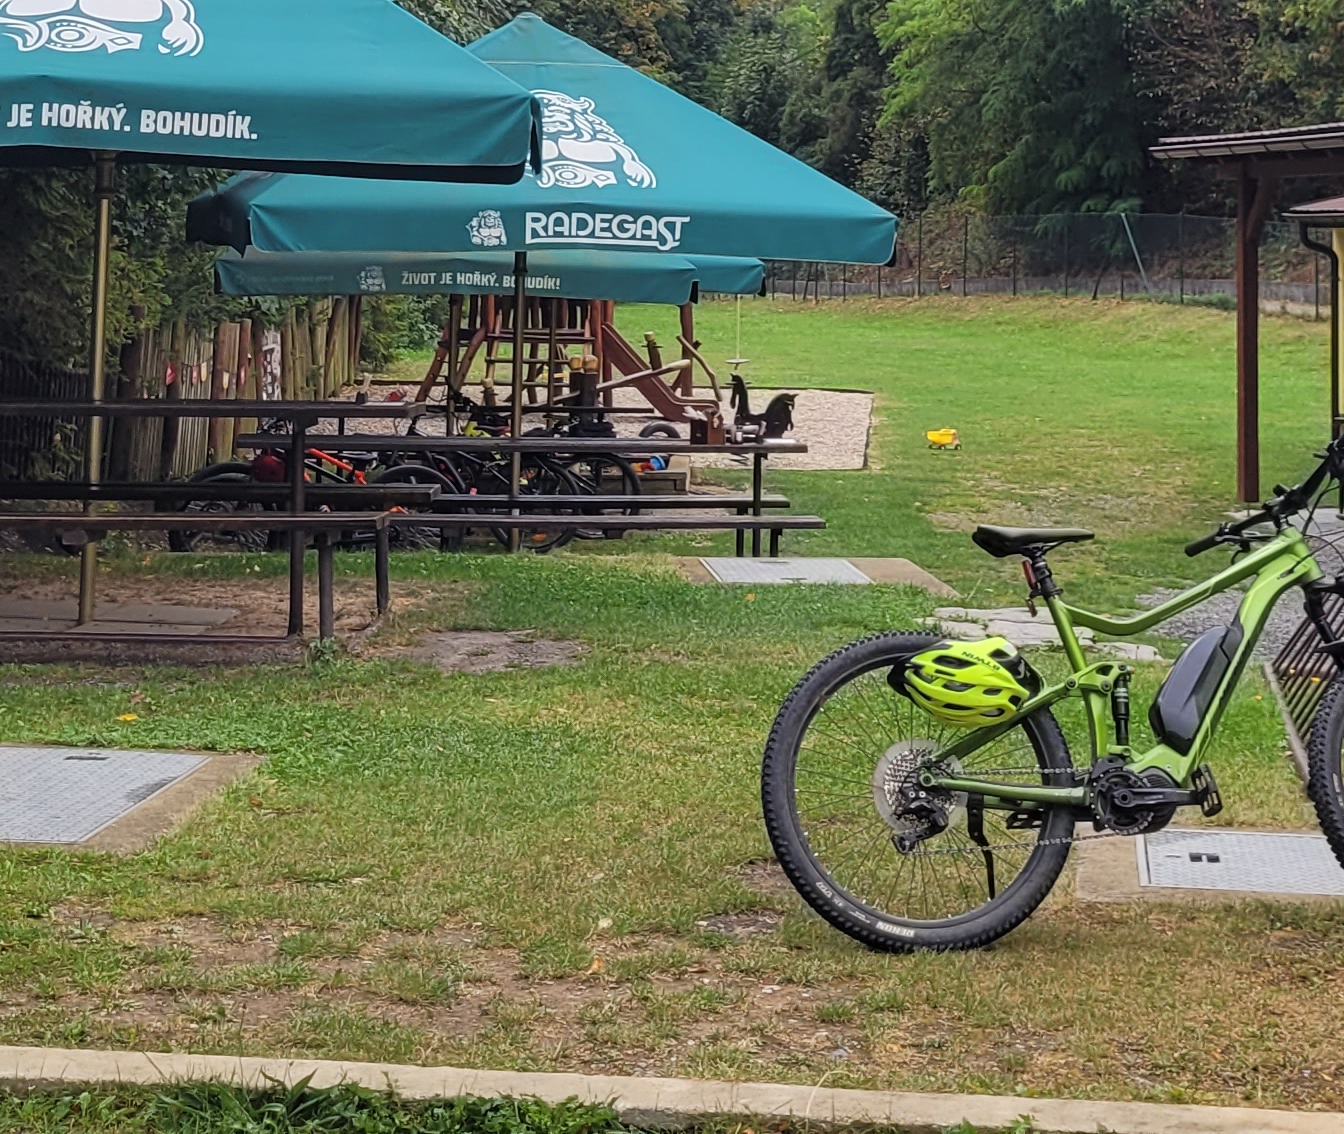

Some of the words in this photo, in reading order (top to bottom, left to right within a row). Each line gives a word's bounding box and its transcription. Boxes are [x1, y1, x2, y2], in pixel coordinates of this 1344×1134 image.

[6, 103, 35, 128] JE
[41, 99, 131, 132] HOŘKÝ.
[139, 108, 258, 140] BOHUDÍK.
[524, 211, 691, 251] RADEGAST
[401, 270, 437, 285] ŽIVOT
[439, 272, 453, 285] JE
[456, 270, 500, 287] HOŘKÝ.
[502, 274, 561, 290] BOUDÍK!
